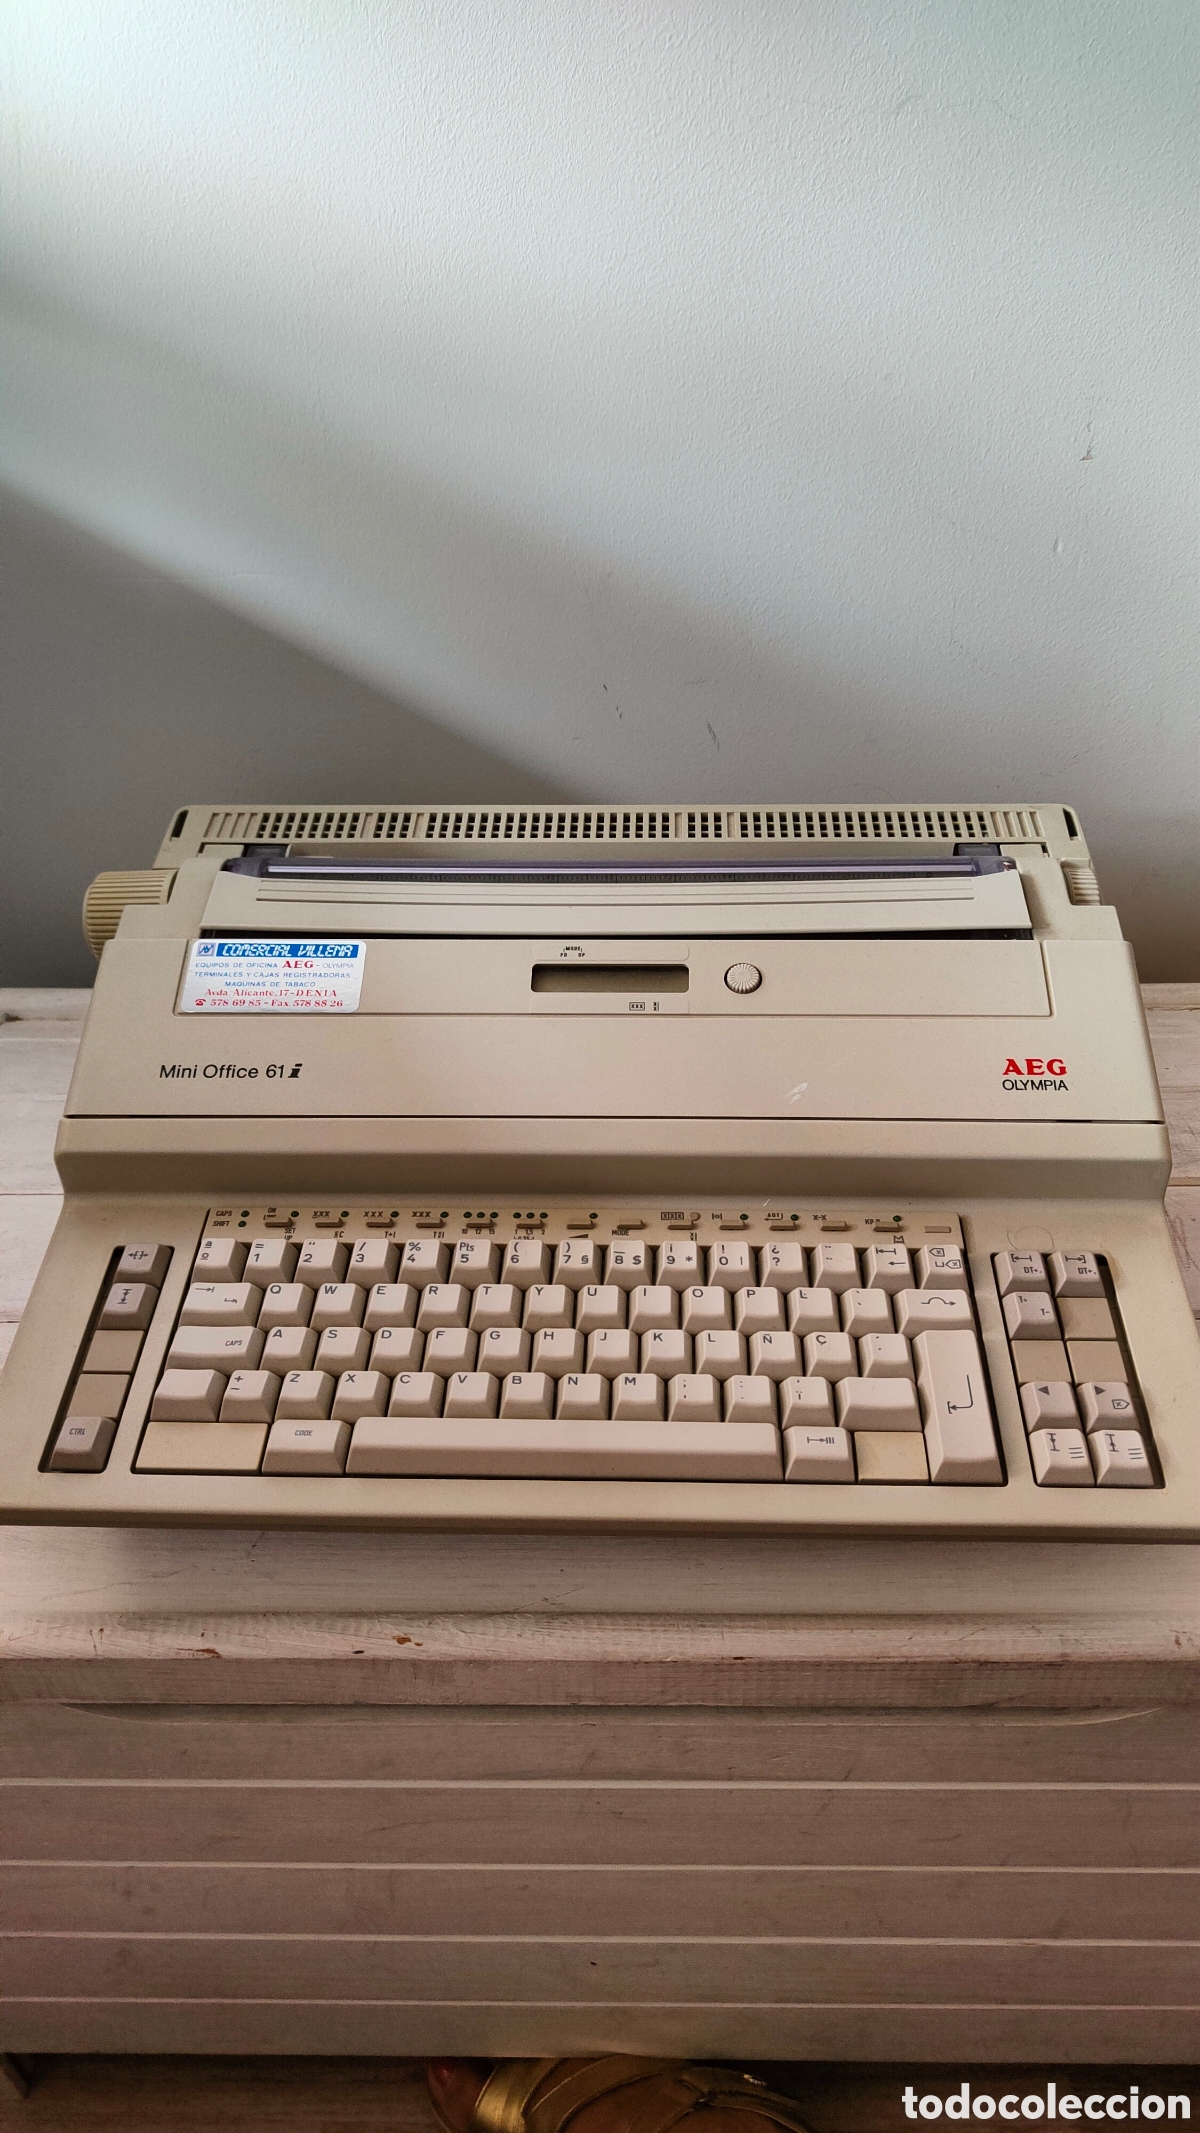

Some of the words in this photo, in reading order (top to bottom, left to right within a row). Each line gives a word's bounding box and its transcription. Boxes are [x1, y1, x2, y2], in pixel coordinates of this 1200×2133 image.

[222, 944, 292, 957] COMERCIAL
[298, 945, 353, 957] VILLENA
[282, 960, 314, 969] AEG
[159, 1064, 198, 1079] Mini
[202, 1063, 259, 1079] Office
[1002, 1058, 1067, 1076] AEG
[1002, 1079, 1069, 1091] OLYMPIA
[459, 1243, 475, 1252] Pts
[254, 1253, 261, 1263] 1
[302, 1253, 313, 1263] 2
[355, 1253, 365, 1263] 3
[407, 1253, 417, 1263] 4
[460, 1254, 469, 1263] 5
[511, 1254, 519, 1264] 6
[563, 1255, 572, 1264] 7
[615, 1255, 623, 1265] 8
[666, 1255, 676, 1265] 9
[270, 1285, 282, 1295] Q
[324, 1285, 338, 1295] W
[376, 1285, 387, 1295] E
[428, 1286, 438, 1295] R
[482, 1286, 492, 1295] T
[535, 1286, 544, 1296] Y
[587, 1287, 597, 1297] U
[692, 1288, 704, 1298] O
[746, 1289, 756, 1299] P
[272, 1329, 284, 1339] A
[327, 1329, 339, 1339] S
[380, 1330, 393, 1339] D
[435, 1330, 446, 1340] F
[489, 1330, 501, 1340] G
[543, 1331, 554, 1341] H
[600, 1332, 607, 1342] J
[653, 1332, 663, 1342] K
[707, 1333, 717, 1343] L
[762, 1333, 773, 1345] Ñ
[815, 1334, 827, 1346] Ç
[289, 1373, 301, 1383] Z
[344, 1373, 357, 1383] X
[399, 1374, 411, 1384] C
[457, 1374, 468, 1384] V
[511, 1375, 522, 1385] B
[567, 1376, 579, 1386] N
[624, 1376, 637, 1386] M
[69, 1427, 86, 1435] CTRL
[294, 1429, 314, 1437] CODE
